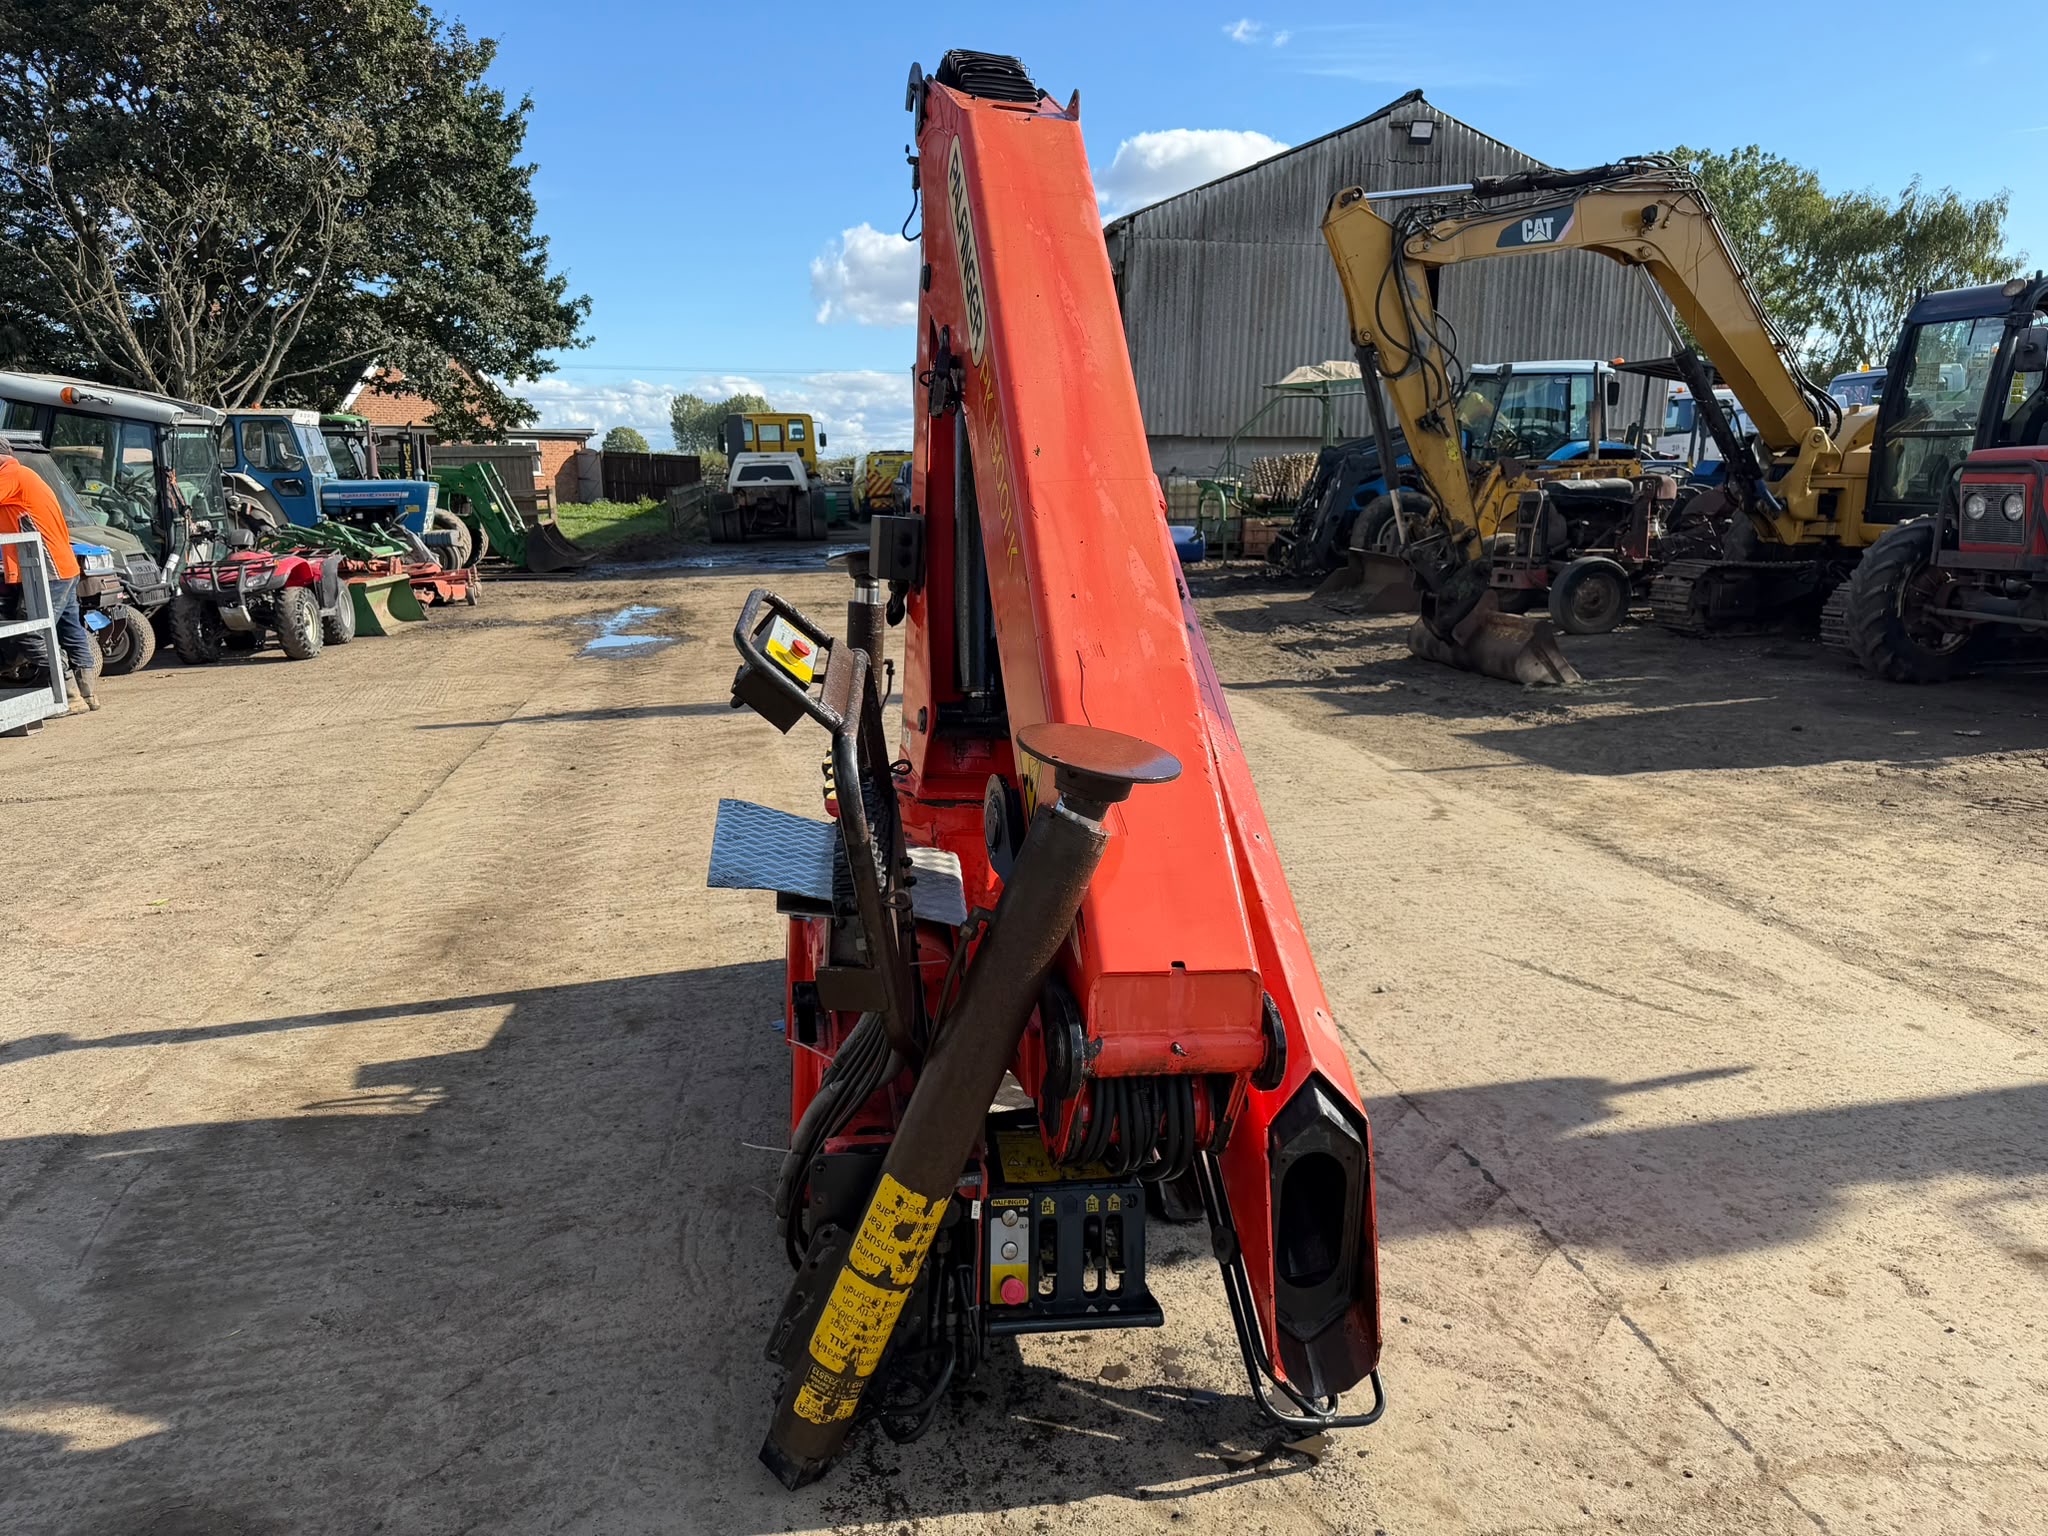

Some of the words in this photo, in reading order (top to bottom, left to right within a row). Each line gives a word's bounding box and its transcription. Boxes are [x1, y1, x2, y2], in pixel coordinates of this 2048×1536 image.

[1521, 217, 1554, 243] CAT
[949, 147, 983, 354] PALFINGER
[979, 354, 994, 420] PK
[875, 1201, 892, 1217] are
[868, 1214, 887, 1233] rear
[862, 1227, 895, 1254] ensure
[842, 1296, 854, 1308] on
[830, 1318, 849, 1336] legs
[830, 1333, 849, 1349] ALL
